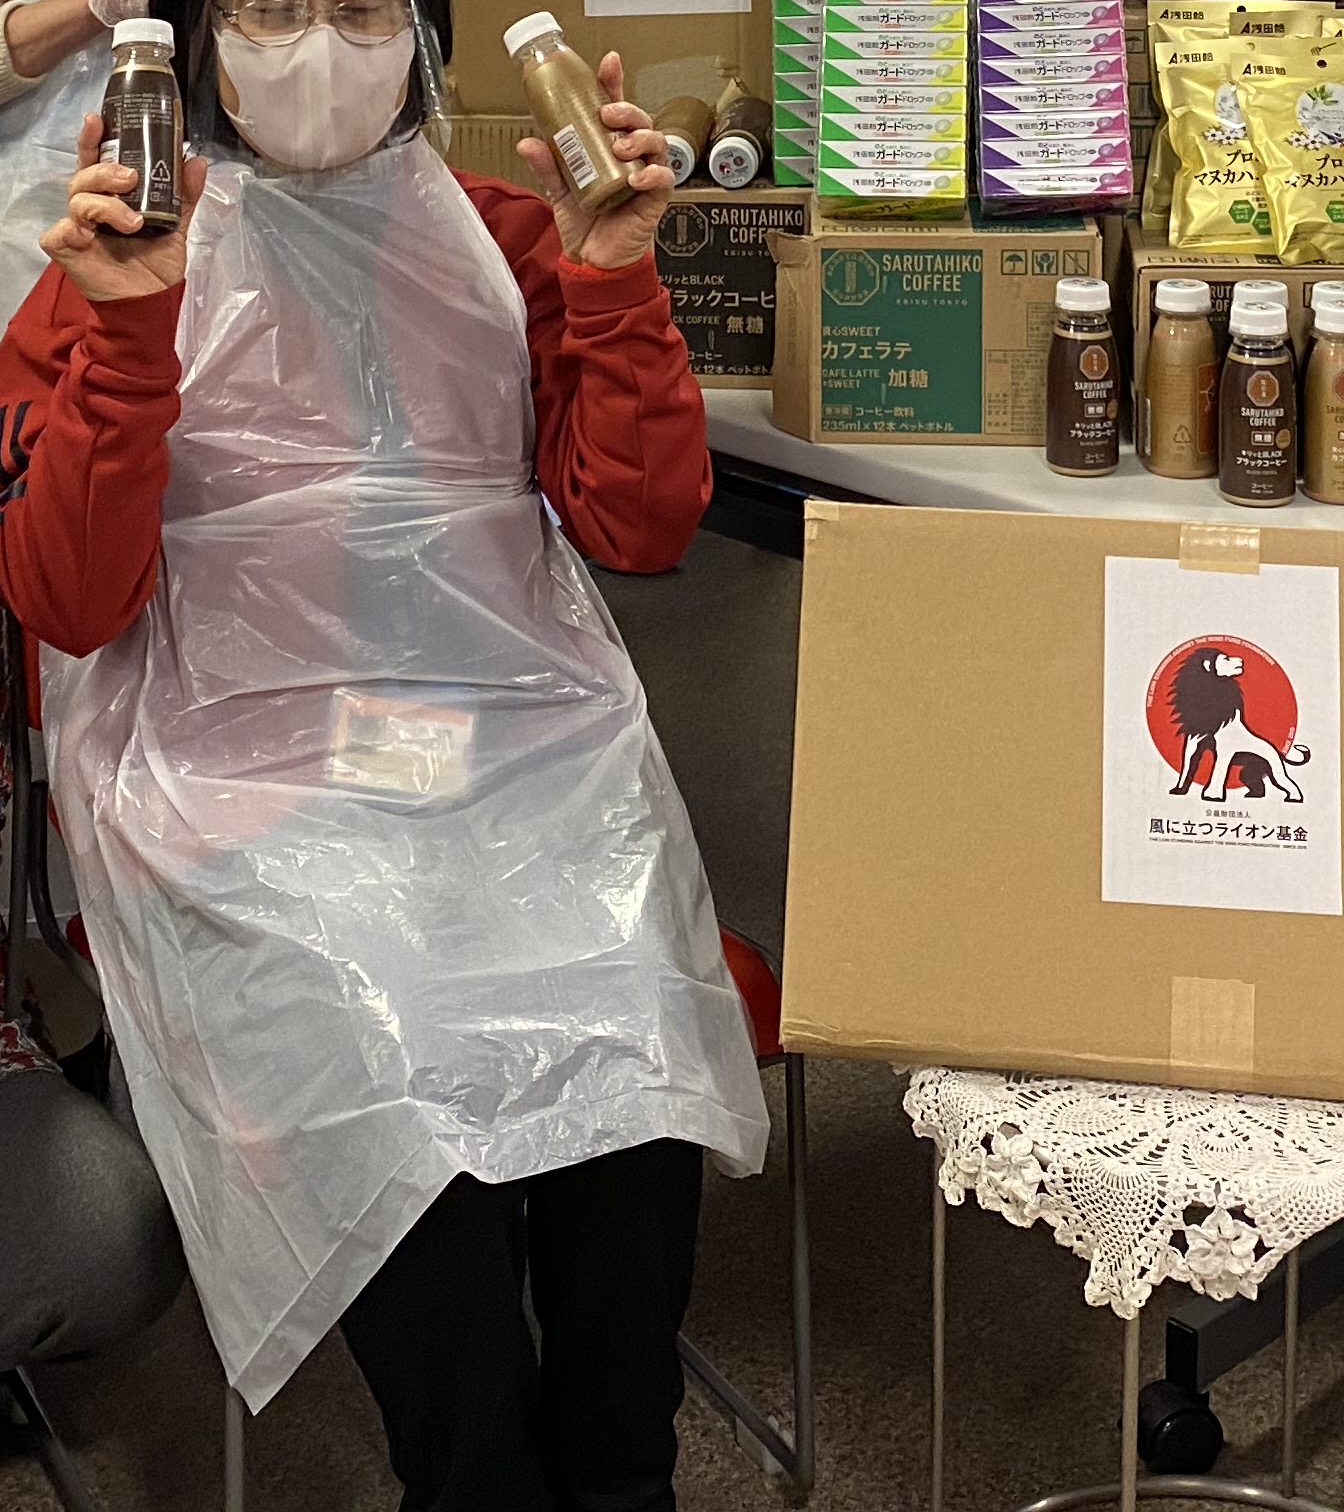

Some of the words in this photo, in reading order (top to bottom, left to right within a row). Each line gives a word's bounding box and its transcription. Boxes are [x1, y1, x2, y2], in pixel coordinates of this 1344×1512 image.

[1226, 150, 1259, 166] プロ
[1194, 169, 1259, 185] マヌカハ
[711, 208, 803, 226] SARUTAHIKO
[730, 227, 784, 244] COFF
[882, 254, 982, 272] SARUTAHIKO
[902, 274, 962, 292] COFFEE
[686, 315, 720, 324] COFFEE
[726, 315, 763, 334] 無糖
[822, 341, 912, 360] カフェラテ
[848, 369, 880, 378] LATTE
[888, 368, 929, 388] 加糖
[1249, 417, 1276, 426] COFFEE
[1149, 819, 1308, 841] 風に立つライオン基金
